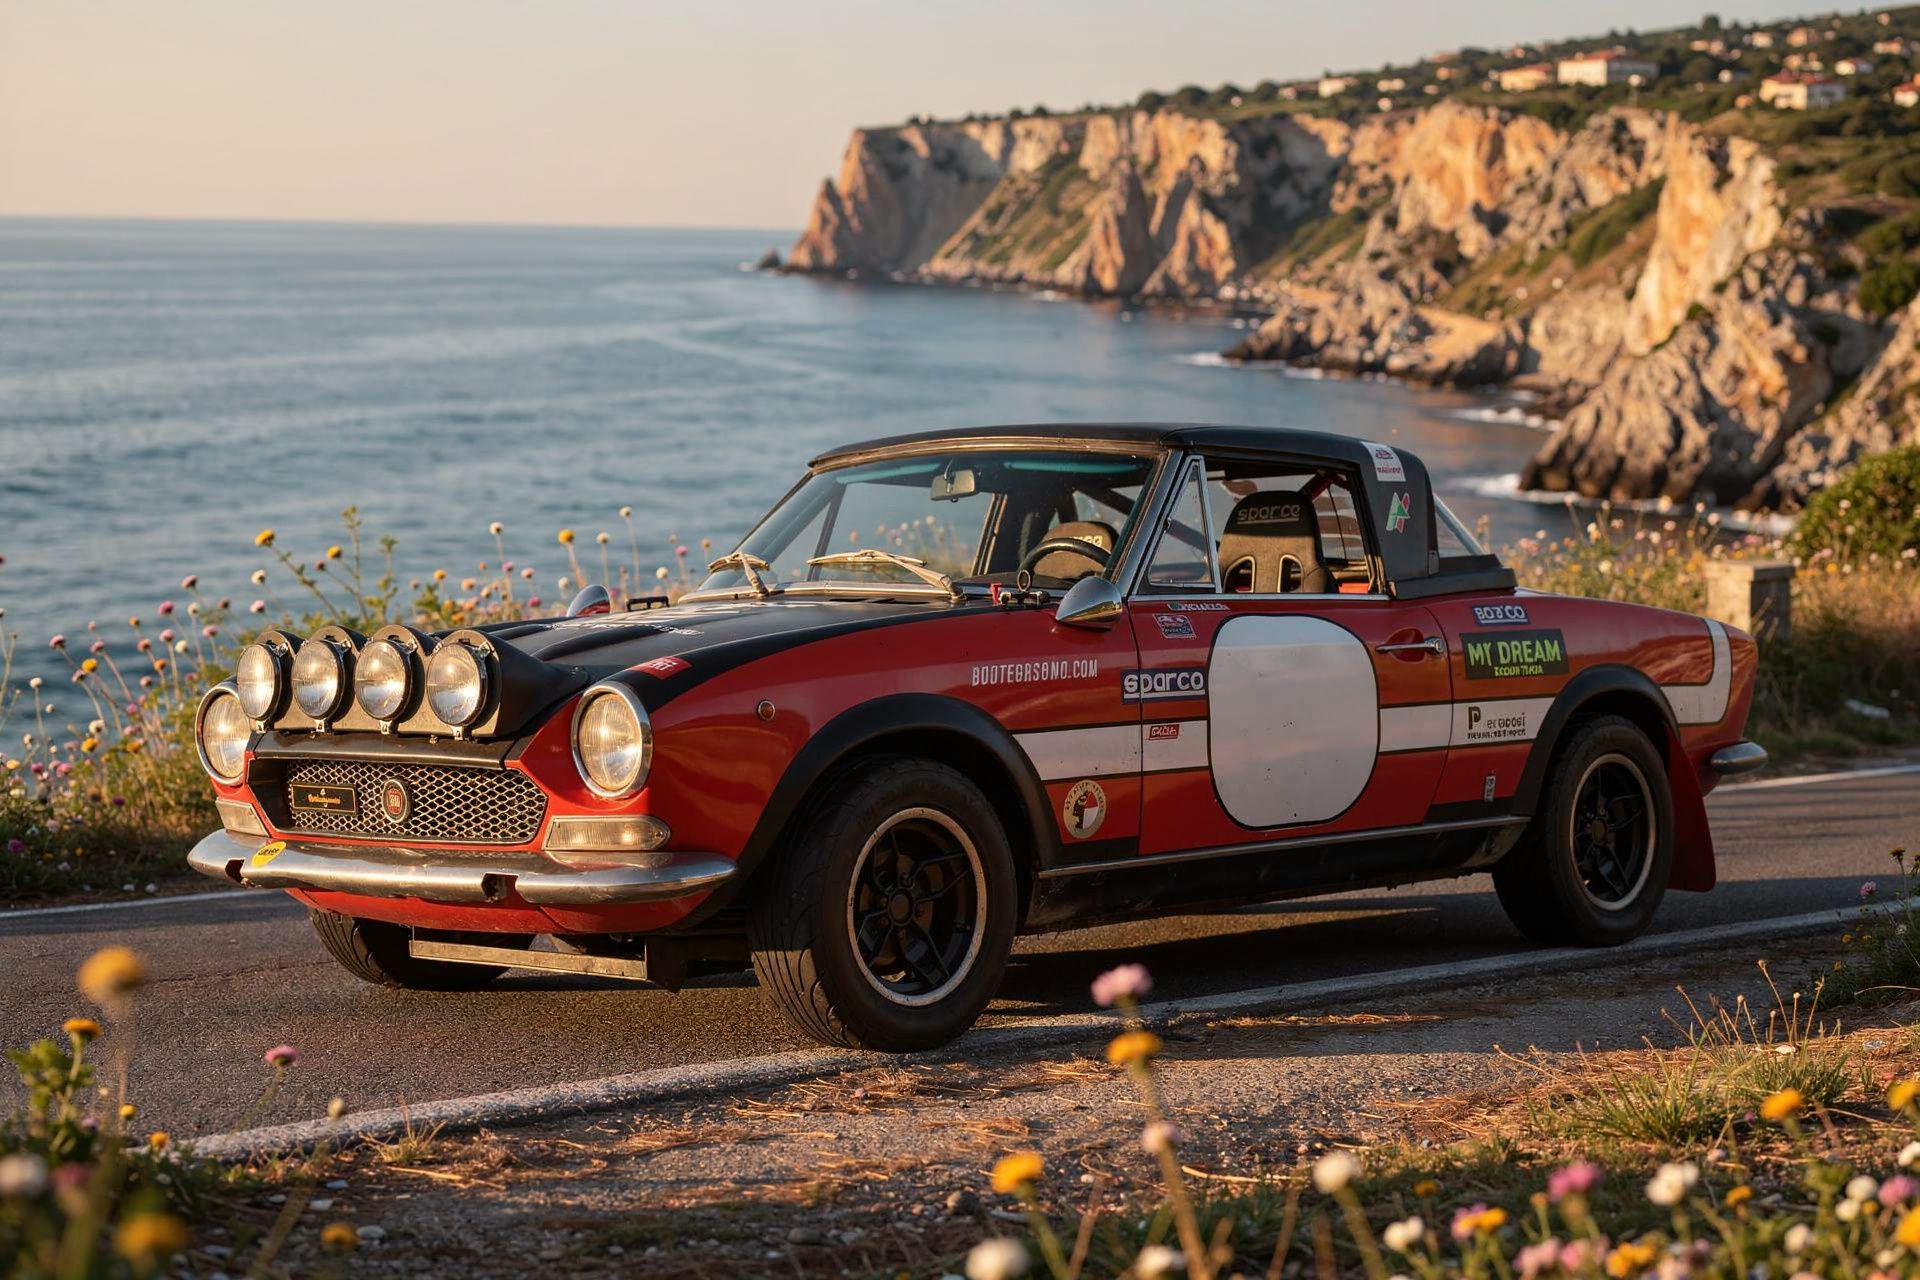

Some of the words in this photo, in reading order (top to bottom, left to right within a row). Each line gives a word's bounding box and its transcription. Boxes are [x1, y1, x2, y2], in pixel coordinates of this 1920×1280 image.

[1468, 642, 1492, 666] MY
[1497, 639, 1561, 664] DREAM
[1123, 671, 1204, 693] sparco
